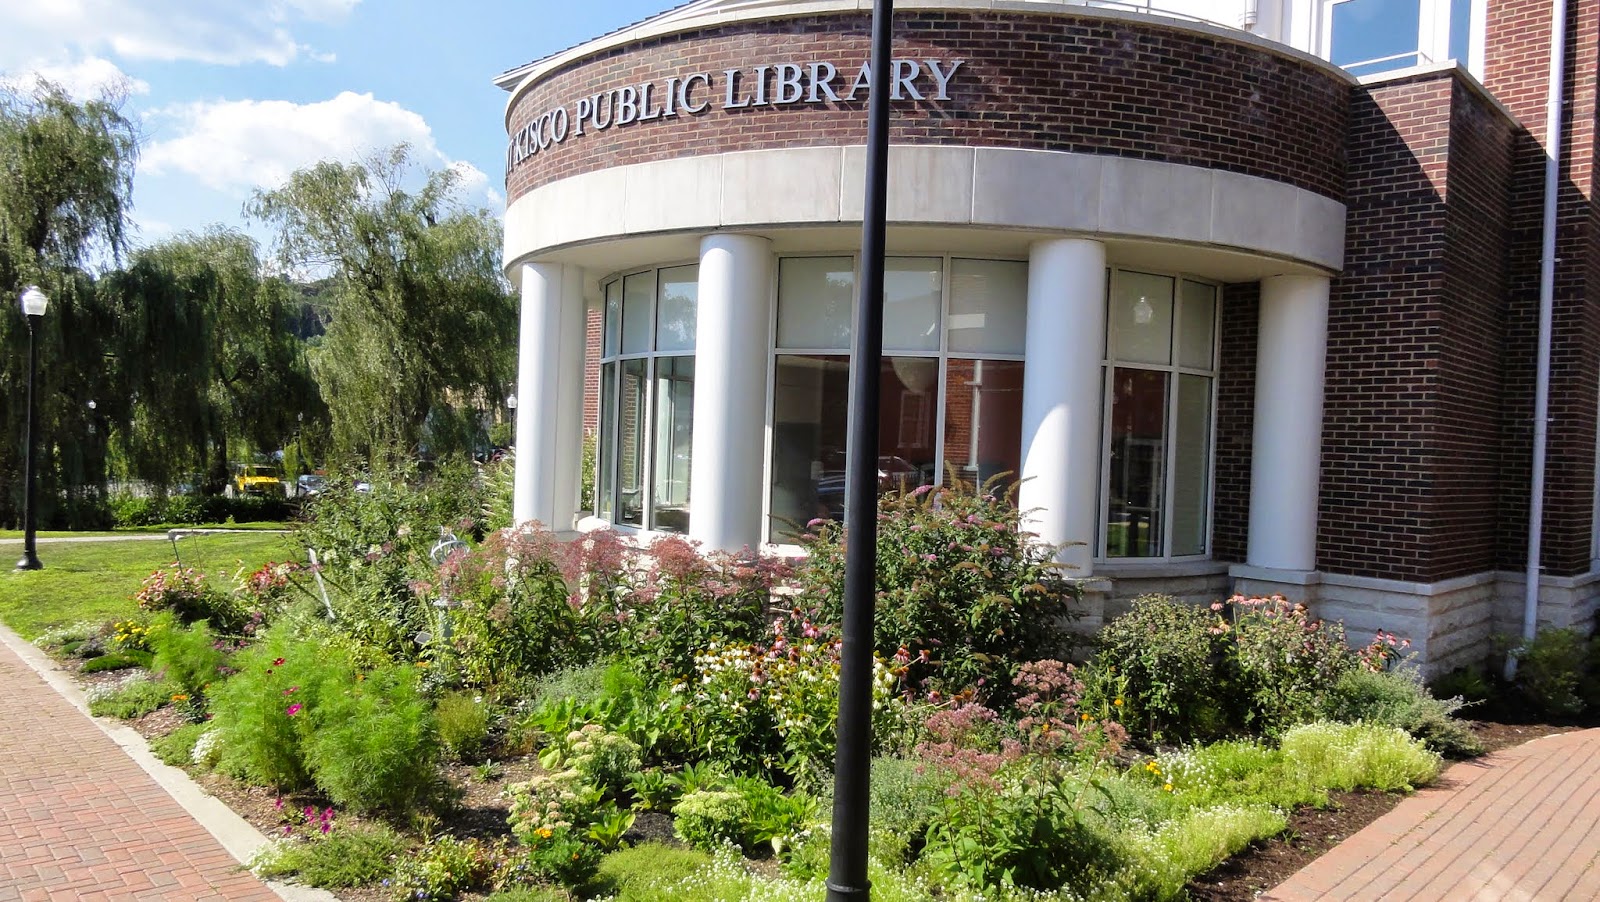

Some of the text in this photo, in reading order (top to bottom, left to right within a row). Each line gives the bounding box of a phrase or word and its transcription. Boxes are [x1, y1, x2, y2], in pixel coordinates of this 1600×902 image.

[513, 106, 568, 165] KISCO
[574, 72, 709, 136] PUBLIC
[721, 59, 965, 109] LIBRARY
